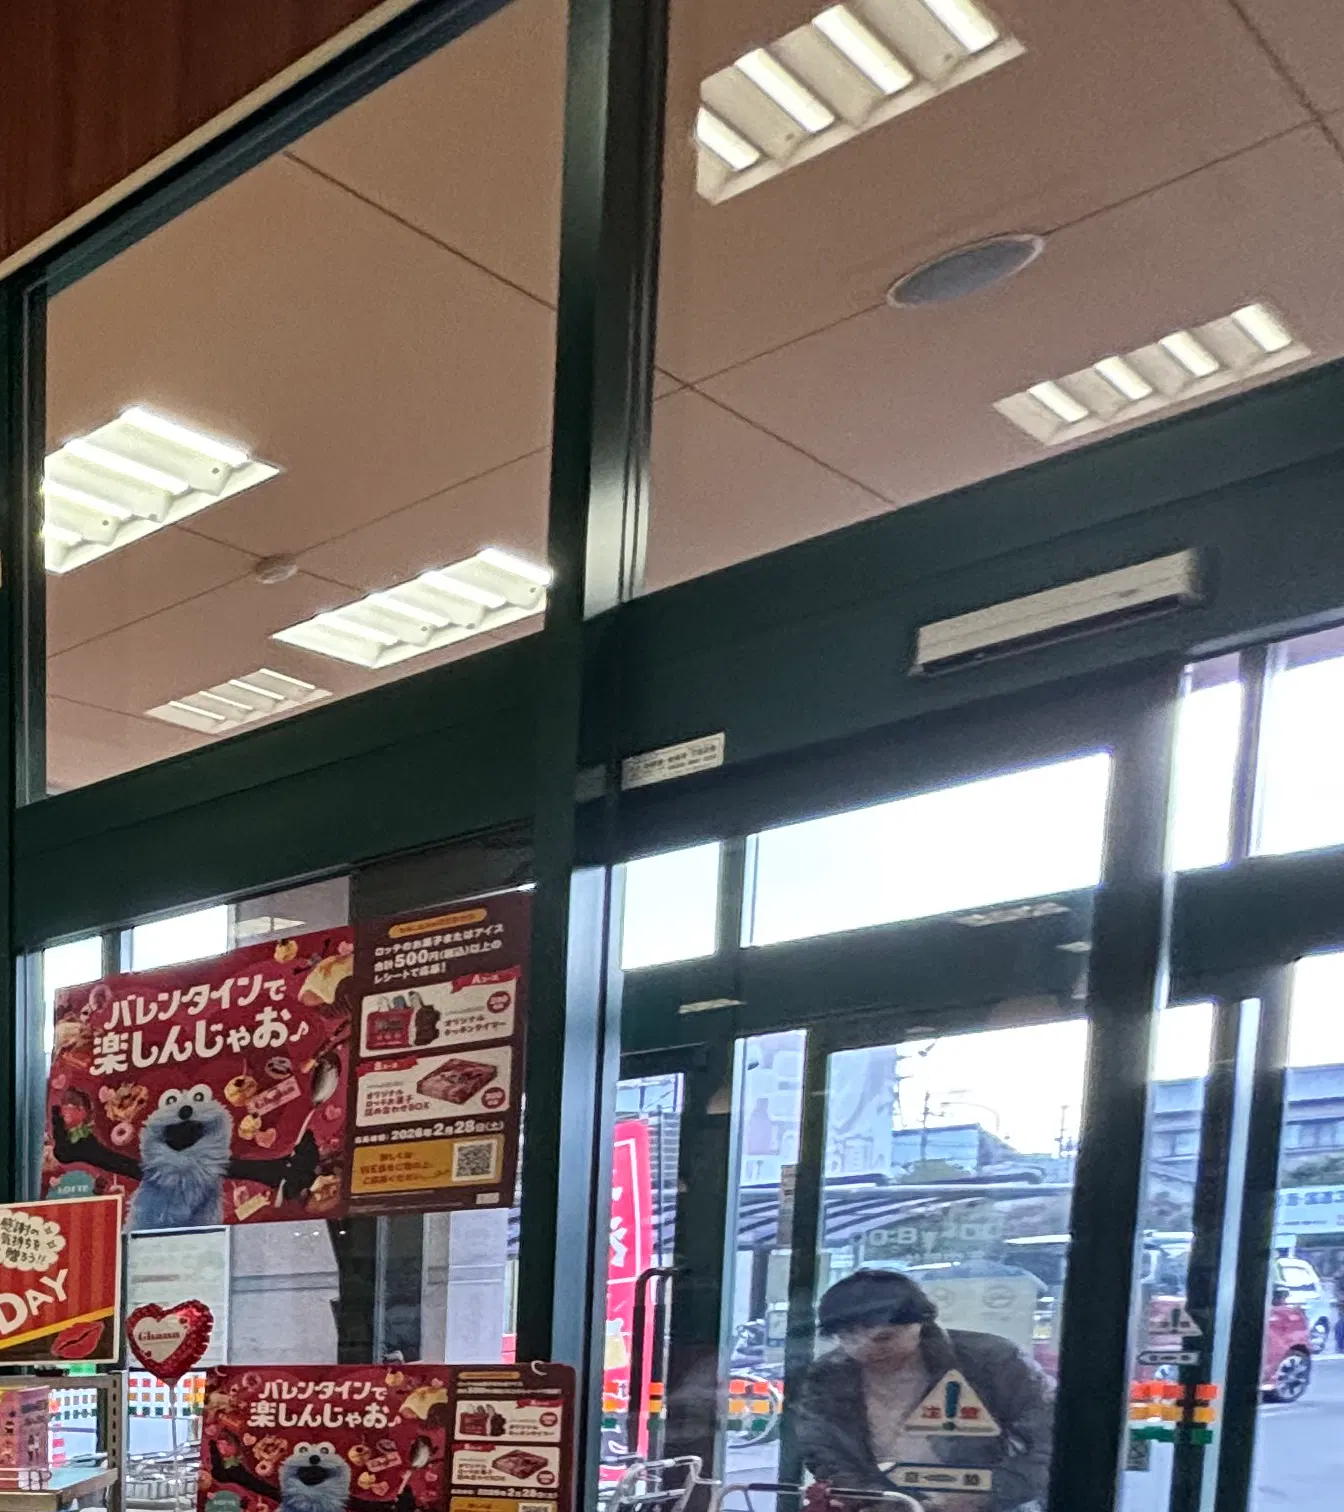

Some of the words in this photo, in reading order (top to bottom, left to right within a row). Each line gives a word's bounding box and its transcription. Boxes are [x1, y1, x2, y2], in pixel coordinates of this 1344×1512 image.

[105, 972, 287, 1030] バレンタインで
[57, 1183, 90, 1195] LOTTE
[137, 1330, 181, 1343] Ghana
[258, 1378, 389, 1401] バレンタインで
